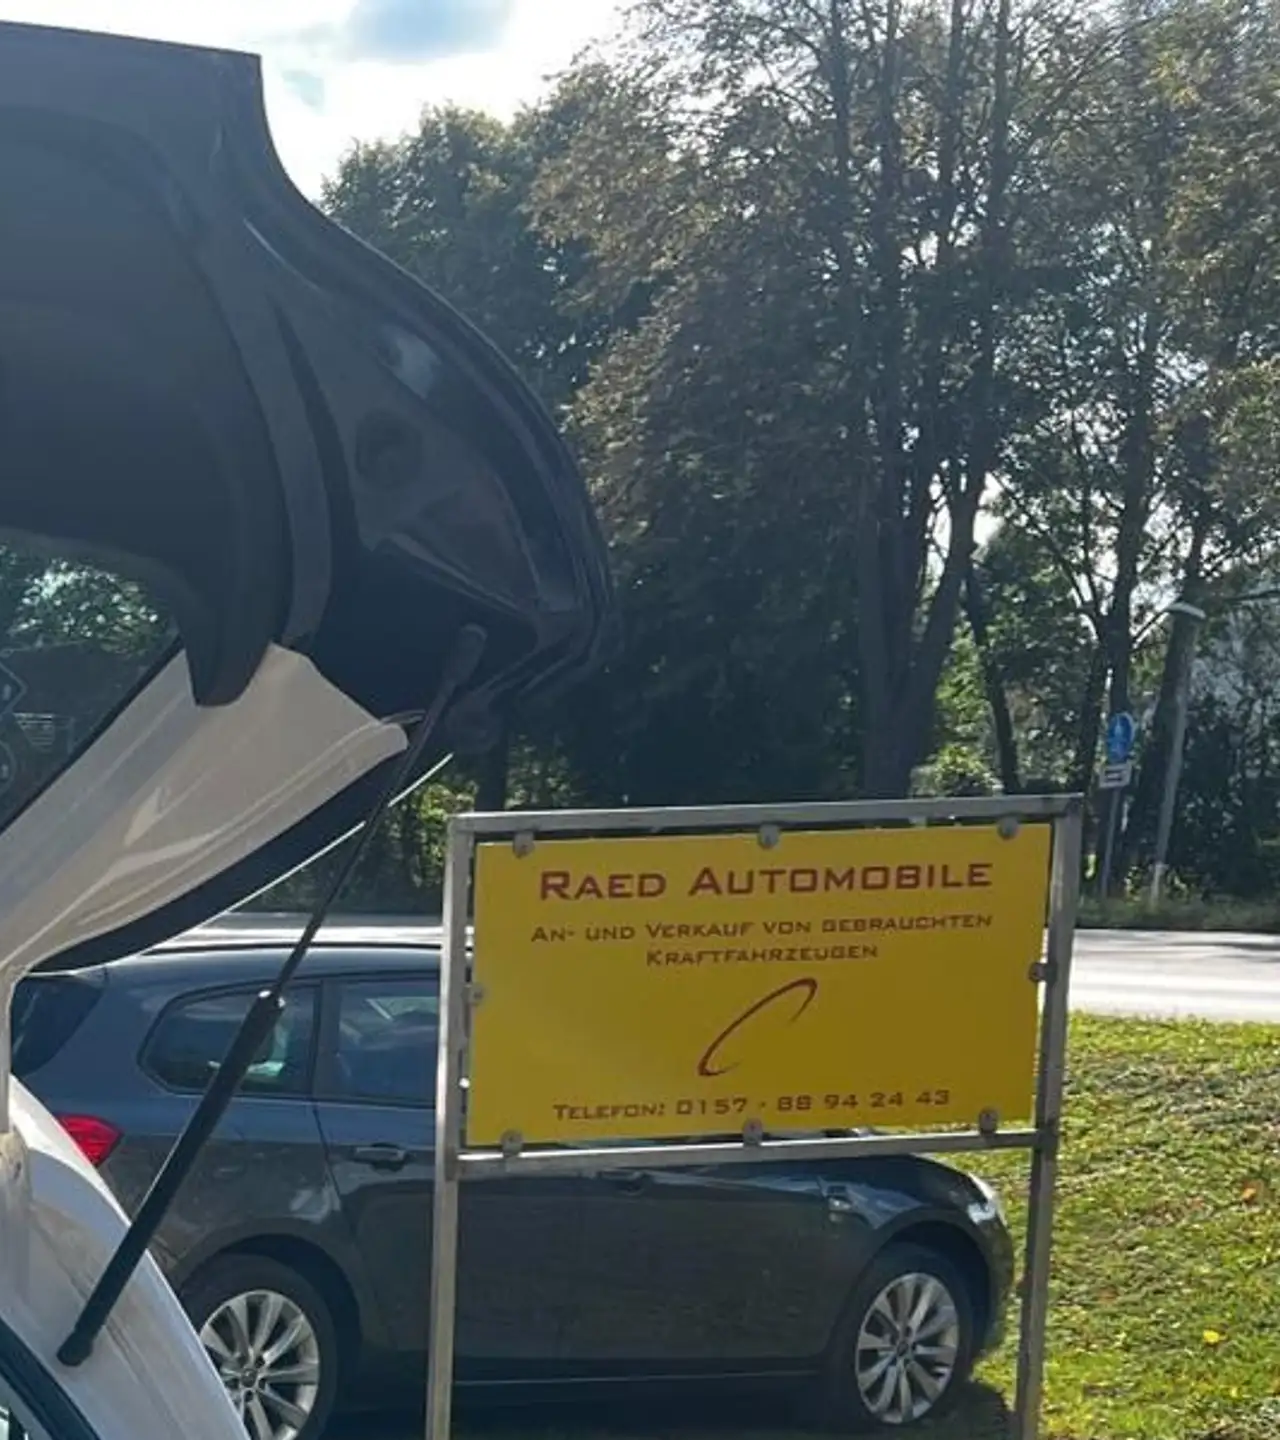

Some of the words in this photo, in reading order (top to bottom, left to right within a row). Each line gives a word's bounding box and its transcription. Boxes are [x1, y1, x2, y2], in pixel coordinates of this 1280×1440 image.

[540, 870, 667, 900] RAED
[688, 863, 994, 897] AUTOMOBILE
[585, 925, 636, 942] UND
[645, 920, 755, 939] VERKAUF
[763, 921, 812, 935] VON
[822, 913, 994, 934] GEBRAUCHTEN
[646, 945, 878, 967] KRAFTFAHRZEUGEN
[676, 1097, 747, 1115] 0157
[777, 1095, 812, 1111] 88
[824, 1094, 859, 1109] 94
[870, 1091, 904, 1107] 24
[915, 1089, 950, 1106] 43
